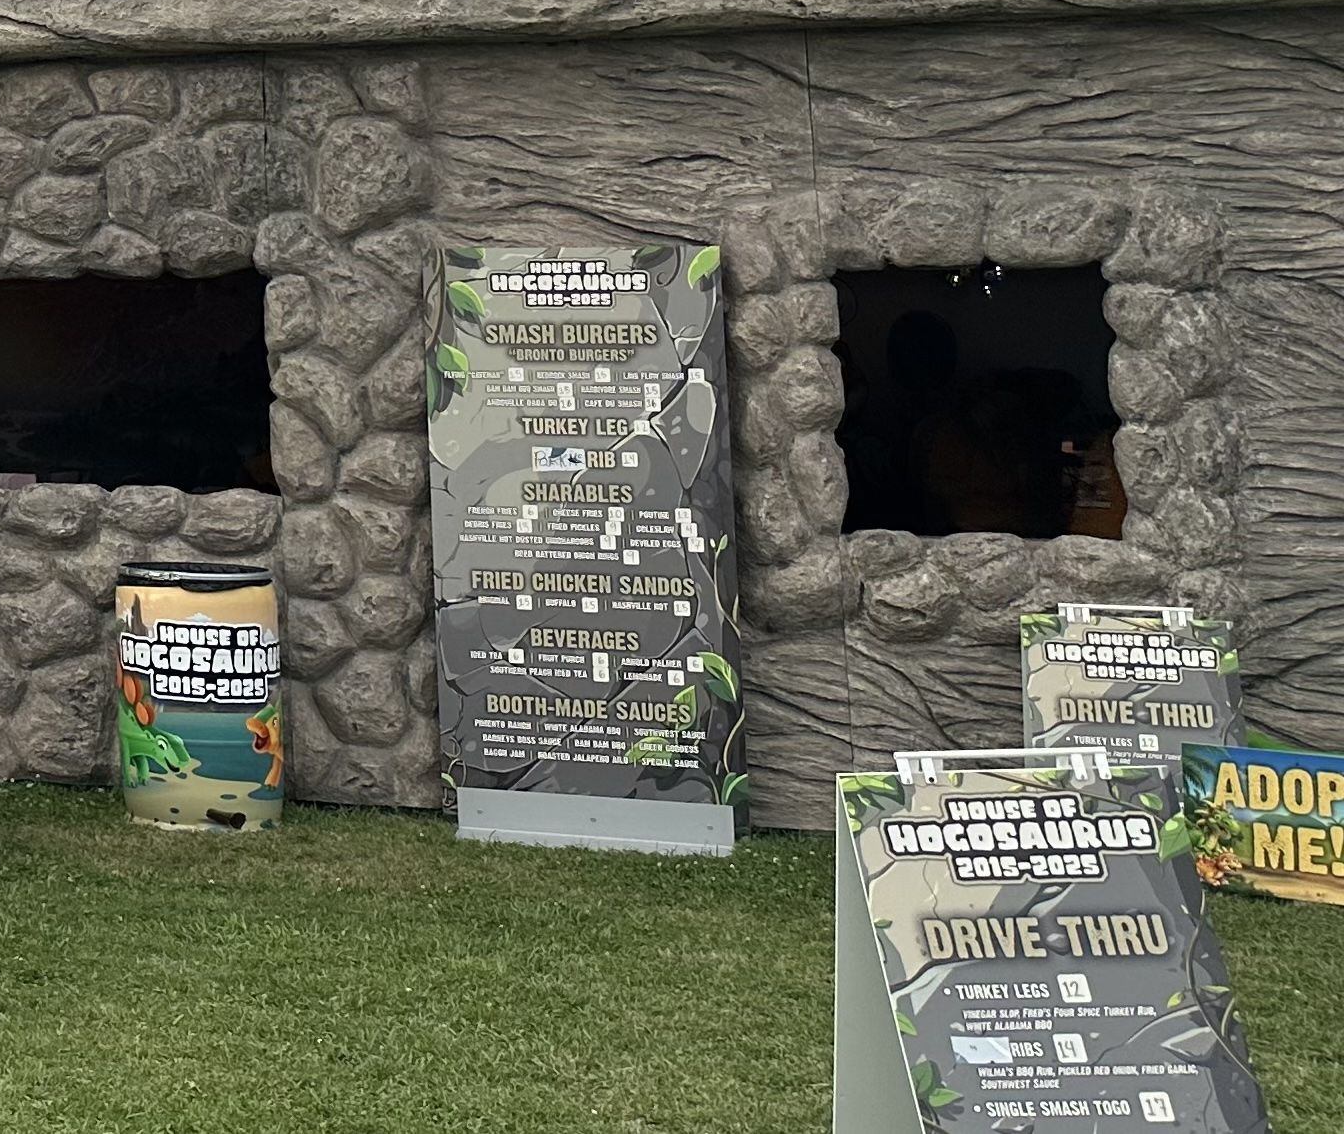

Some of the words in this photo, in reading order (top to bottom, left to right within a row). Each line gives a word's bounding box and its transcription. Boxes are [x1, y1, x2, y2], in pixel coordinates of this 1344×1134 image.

[530, 262, 581, 274] HOUSE
[585, 262, 606, 274] OF
[491, 274, 646, 291] HOGOSAURUS
[527, 294, 611, 306] 2015-2025
[486, 324, 555, 344] SMASH
[563, 324, 657, 345] BURGERS
[522, 418, 588, 435] TURKEY
[596, 419, 628, 436] LEG
[587, 451, 616, 468] RIB
[523, 483, 633, 503] SHARABLES
[471, 570, 524, 590] FRIED
[532, 572, 611, 594] CHICKEN
[620, 576, 695, 596] SANDOS
[159, 625, 231, 646] HOUSE
[236, 629, 259, 647] OF
[530, 628, 639, 651] BEVERAGES
[1088, 633, 1144, 647] HOUSE
[1147, 635, 1170, 648] OF
[1045, 643, 1217, 668] HOGOSAURUS
[1086, 665, 1179, 681] 2015-2025
[155, 674, 264, 697] 2015-2025
[486, 694, 608, 719] BOOTH-MADE
[616, 702, 691, 724] SAUCES
[1060, 698, 1135, 724] DRIVE
[1145, 702, 1214, 728] THRU
[1073, 735, 1107, 746] TURKEY
[1110, 737, 1133, 747] LEGS
[1213, 762, 1344, 817] ADOP
[948, 799, 1035, 820] HOUSE
[1042, 798, 1077, 818] OF
[887, 818, 1152, 853] HOGOSAURUS
[1253, 822, 1344, 877] ME!
[956, 854, 1100, 878] 2015-2025
[923, 917, 1047, 960] DRIVE
[1056, 914, 1169, 956] THRU
[955, 984, 1011, 1000] TURKEY
[1013, 983, 1050, 999] LEGS
[962, 1009, 997, 1019] VINEGAR
[1023, 1008, 1051, 1018] FRED'S
[1054, 1007, 1074, 1017] FOUR
[1077, 1007, 1100, 1017] SPICE
[1104, 1006, 1135, 1016] TURKEY
[1138, 1006, 1157, 1017] RUB,
[965, 1021, 992, 1031] WHITE
[994, 1021, 1033, 1031] ALABAMA
[1034, 1020, 1053, 1031] BBQ
[1010, 1041, 1044, 1057] RIBS
[977, 1067, 1014, 1077] WILMA'S
[1016, 1067, 1034, 1077] BBQ
[1036, 1066, 1055, 1077] RUB,
[1058, 1066, 1091, 1077] PICKLED
[1093, 1066, 1110, 1076] RED
[1141, 1065, 1165, 1075] FRIED
[1167, 1065, 1199, 1076] GARLIC,
[980, 1080, 1032, 1090] SOUTHWEST
[1034, 1079, 1060, 1089] SAUCE
[985, 1102, 1036, 1118] SINGLE
[1041, 1101, 1090, 1116] SMASH
[1095, 1100, 1131, 1115] TOGO
